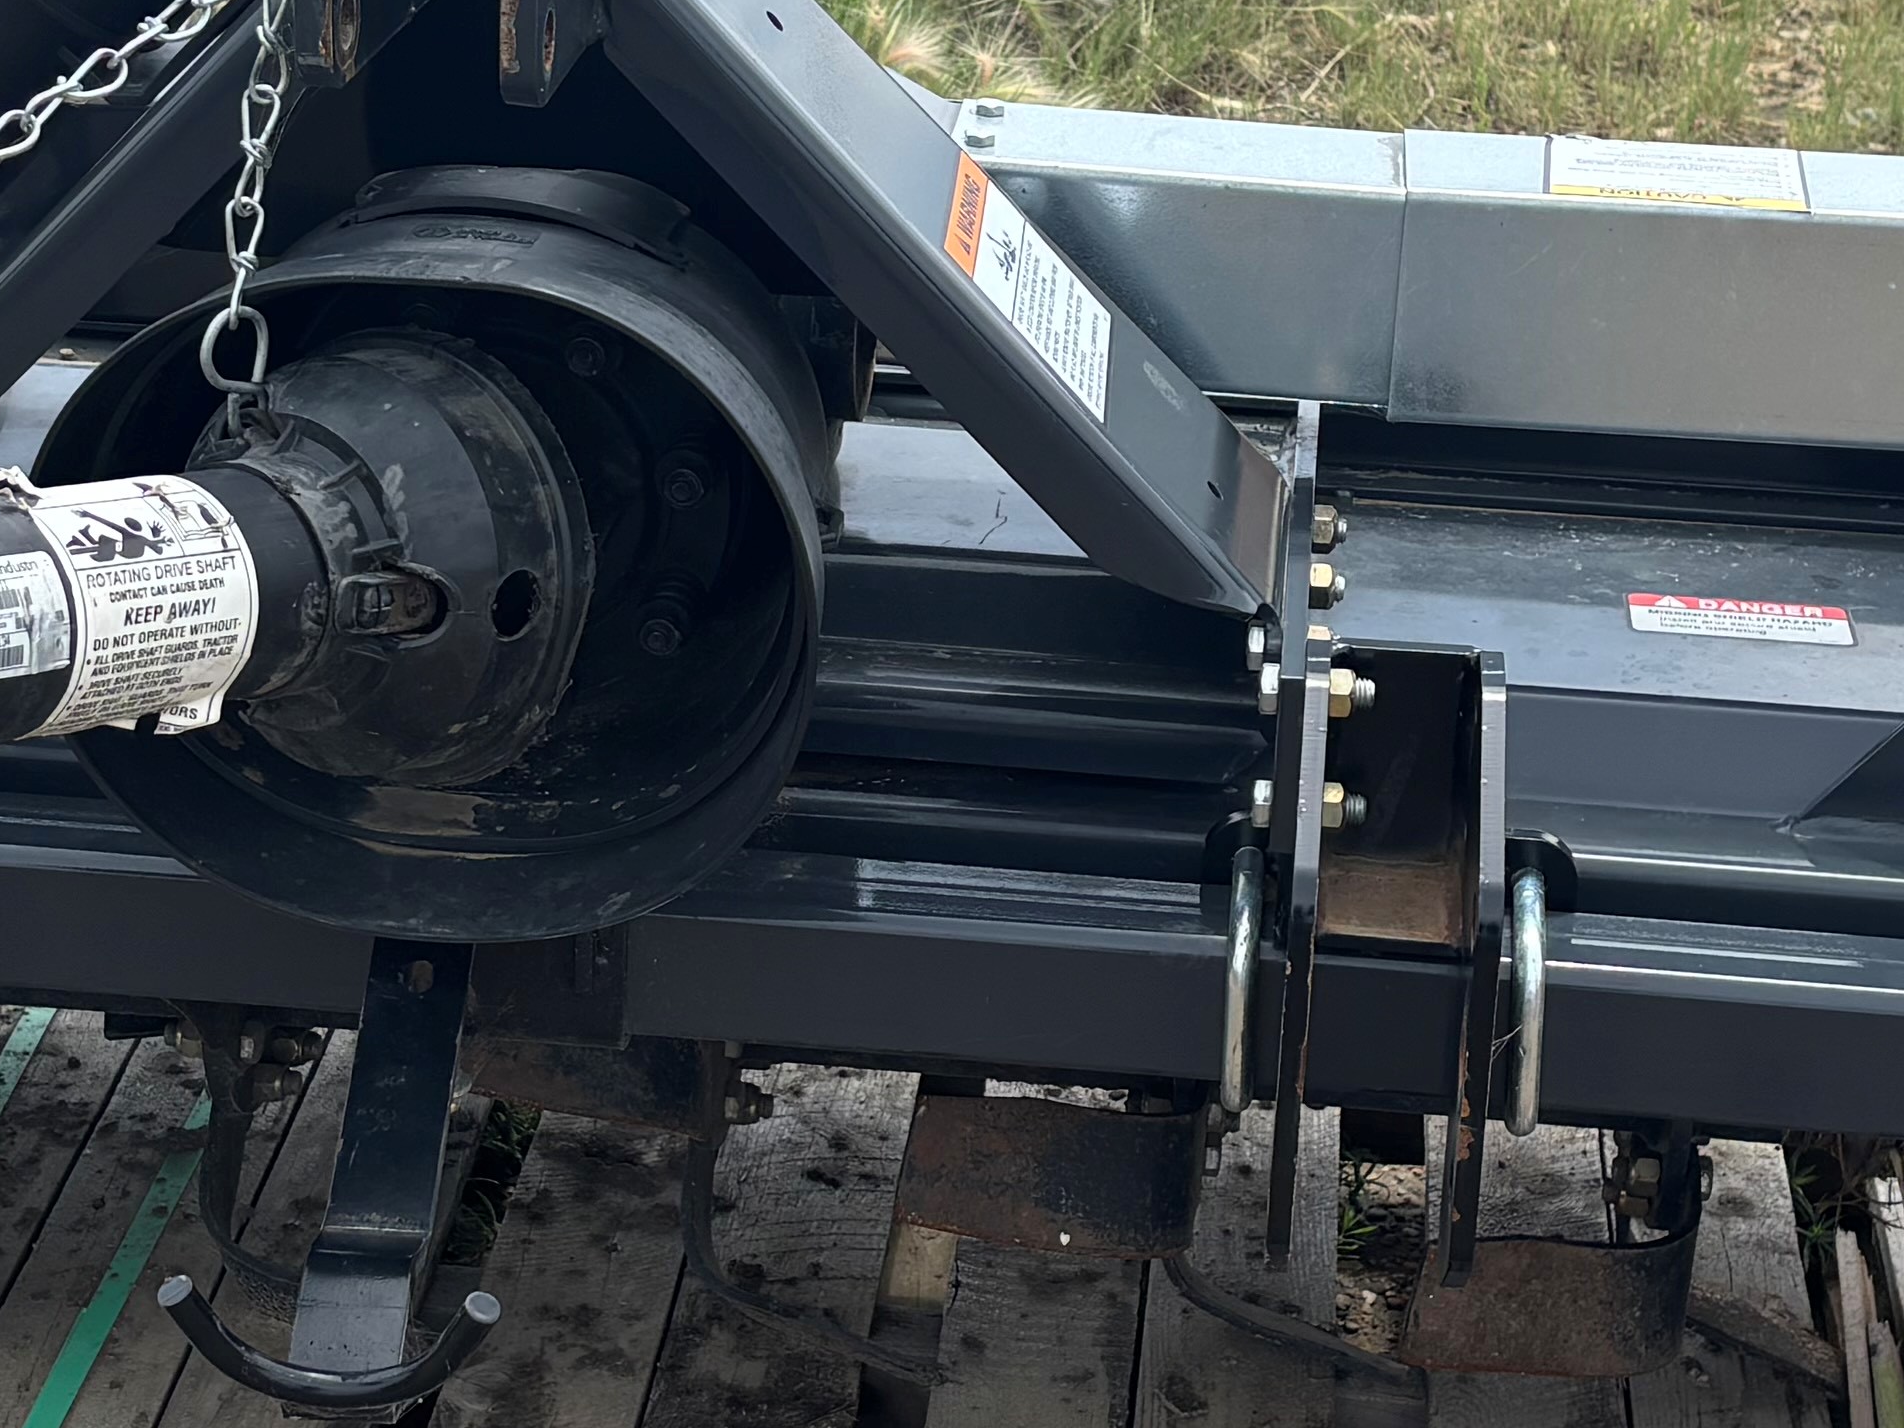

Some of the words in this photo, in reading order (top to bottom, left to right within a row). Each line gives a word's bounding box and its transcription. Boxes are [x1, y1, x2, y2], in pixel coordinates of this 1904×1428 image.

[956, 172, 981, 240] WARNING
[1599, 187, 1707, 200] CAUTION
[86, 567, 151, 589] ROTATING
[155, 561, 194, 580] DRIVE
[197, 556, 236, 574] SHAFT
[109, 587, 147, 603] CONTACT
[151, 584, 168, 596] CAN
[170, 581, 197, 594] CAUSE
[199, 577, 225, 590] DEATH
[124, 604, 163, 627] KEEP
[167, 597, 216, 622] AWAY!
[1698, 598, 1824, 617] DANGER
[93, 638, 109, 651] DO
[113, 633, 135, 648] NOT
[139, 626, 186, 644] OPERATE
[94, 654, 109, 665] ALL
[202, 634, 238, 648] TRACTOR
